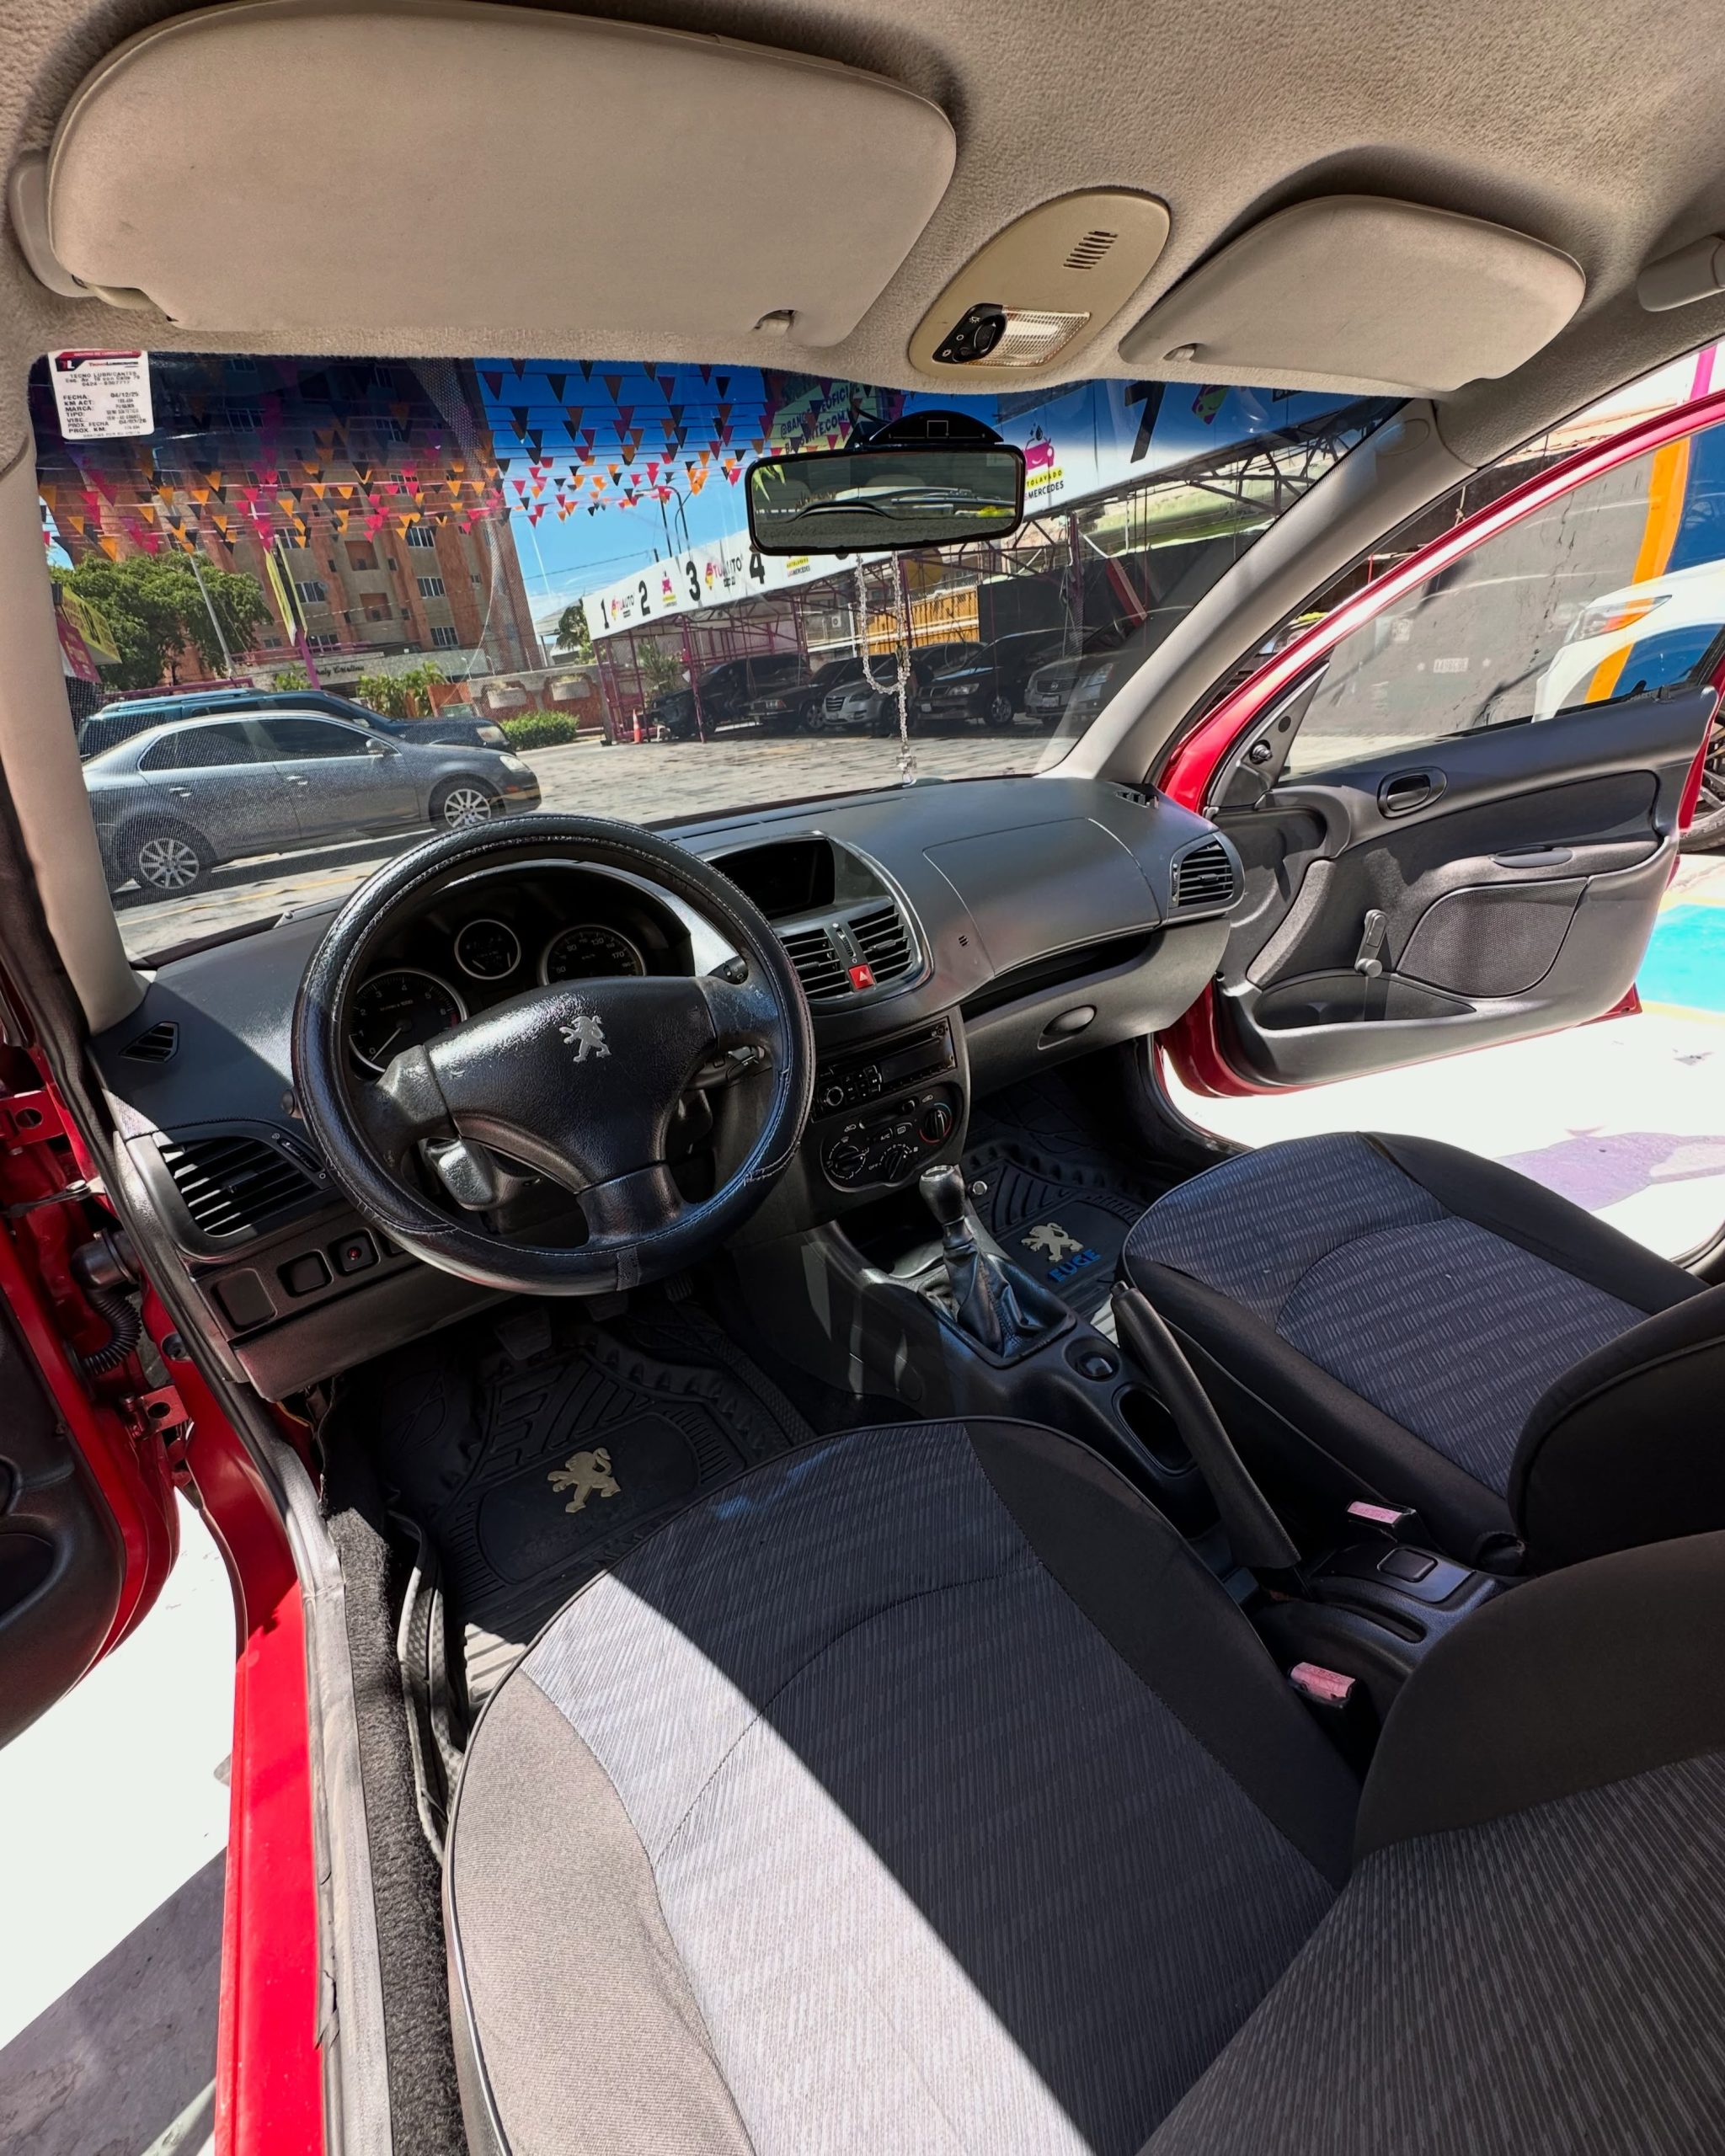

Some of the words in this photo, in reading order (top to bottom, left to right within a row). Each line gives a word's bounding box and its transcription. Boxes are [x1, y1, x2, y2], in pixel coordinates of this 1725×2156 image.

[1124, 381, 1166, 463] 7
[1026, 469, 1063, 488] TOLAVADO
[686, 560, 701, 601] 3
[749, 553, 765, 584] 4
[638, 579, 651, 616] 2
[601, 598, 610, 630] 1
[611, 951, 625, 959] 170
[376, 990, 382, 999] 3
